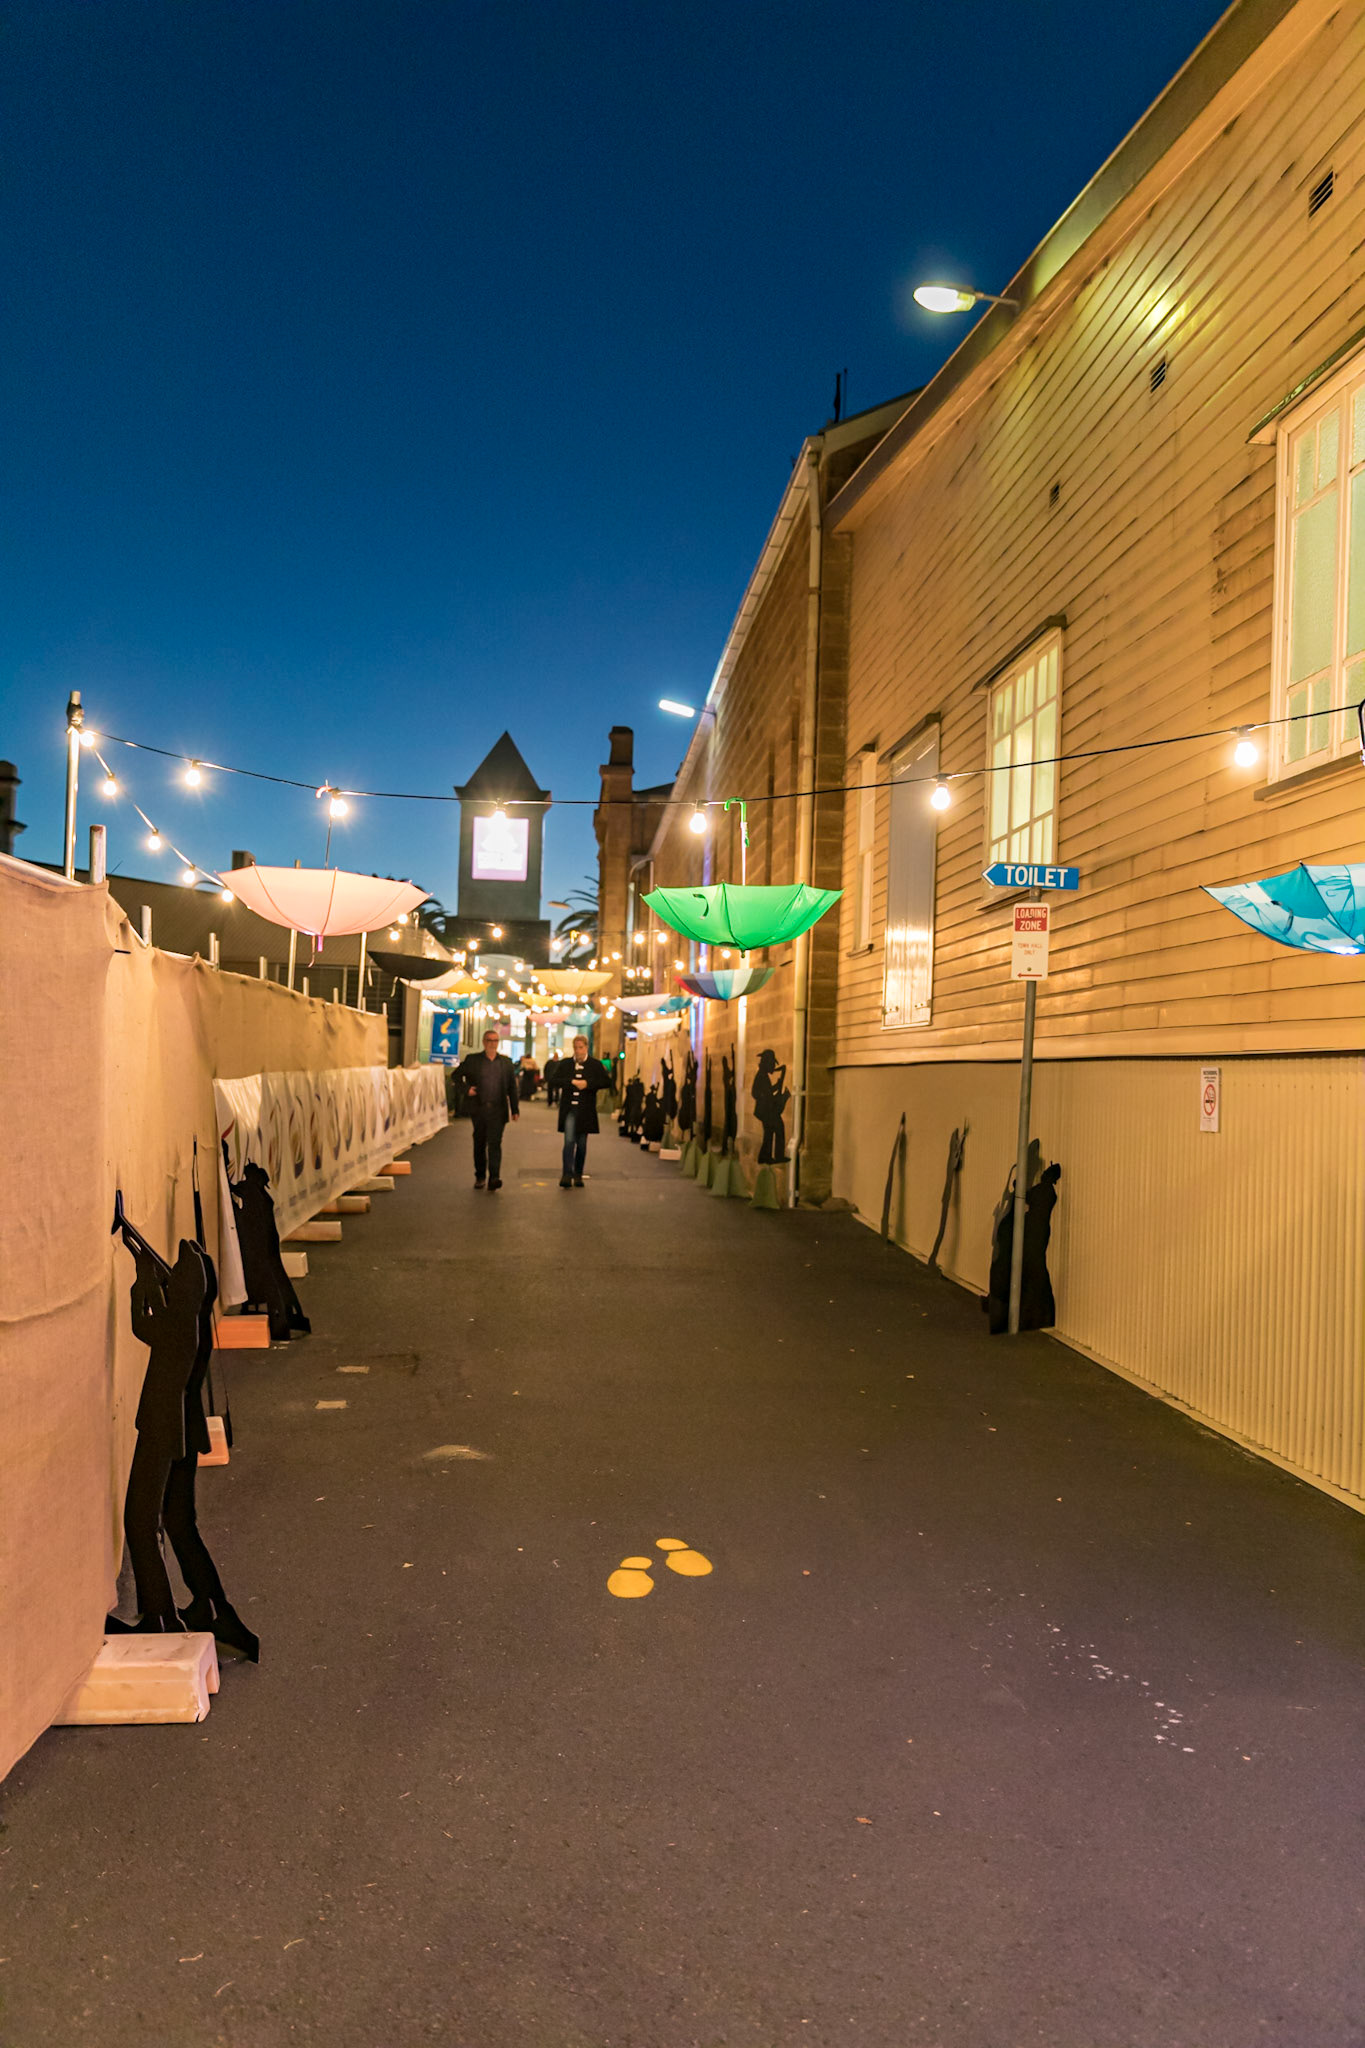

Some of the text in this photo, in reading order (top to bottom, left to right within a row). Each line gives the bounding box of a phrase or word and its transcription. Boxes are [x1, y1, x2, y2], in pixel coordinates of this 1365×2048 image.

[1004, 865, 1068, 887] TOILET
[1016, 908, 1047, 919] LOADING
[1020, 920, 1041, 931] ZONE
